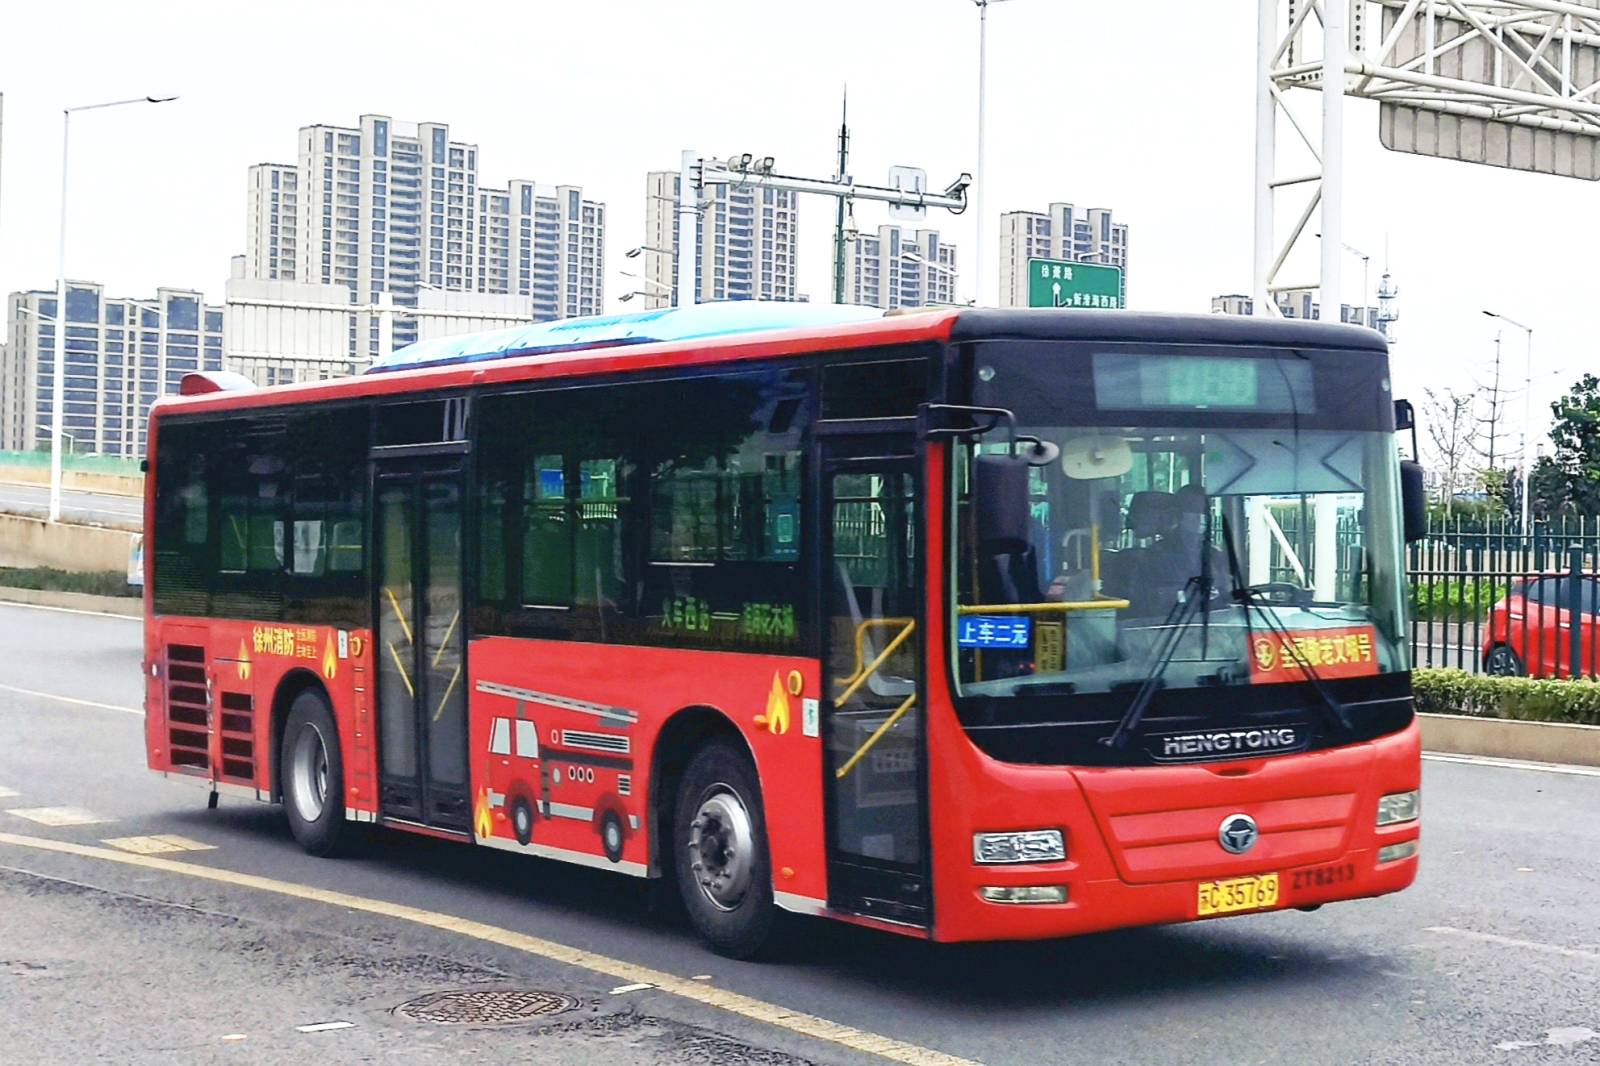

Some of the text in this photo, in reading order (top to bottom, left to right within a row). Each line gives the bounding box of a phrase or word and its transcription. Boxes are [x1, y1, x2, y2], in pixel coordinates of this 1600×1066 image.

[252, 626, 295, 656] 徐州消防
[959, 622, 1027, 644] 上车二元
[1163, 729, 1295, 754] HENGTONG
